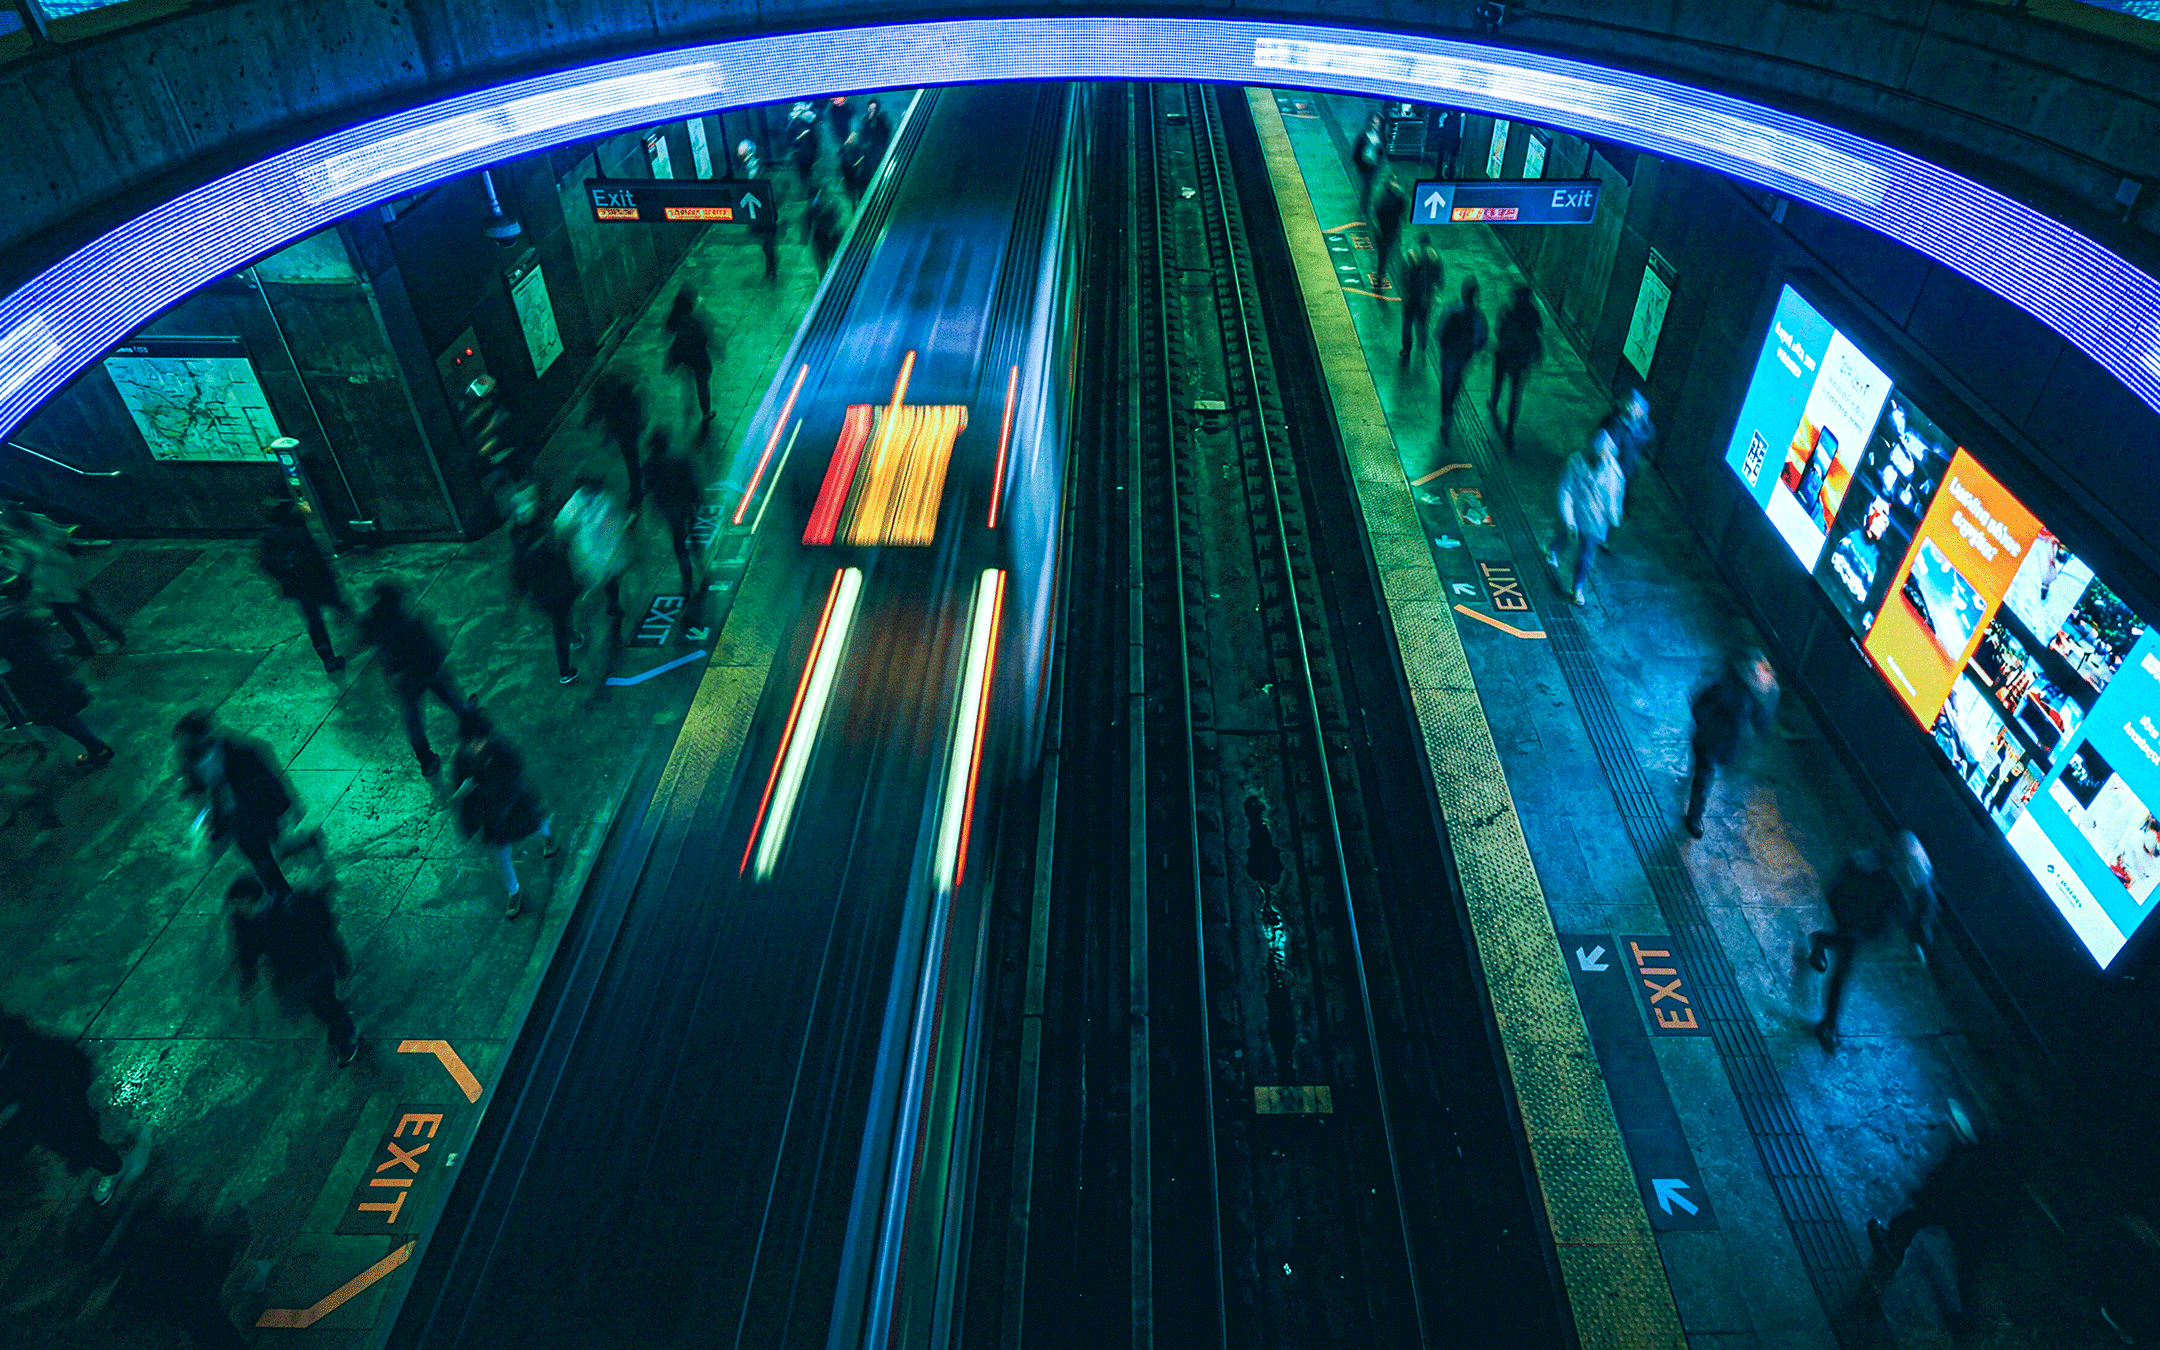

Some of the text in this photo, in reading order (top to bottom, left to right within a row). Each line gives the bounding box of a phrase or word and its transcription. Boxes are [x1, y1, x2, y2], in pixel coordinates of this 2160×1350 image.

[592, 189, 637, 207] Exit
[1551, 190, 1593, 208] Exit
[1481, 563, 1528, 610] EXIT
[638, 596, 685, 645] EXIT
[1630, 941, 1698, 1029] EXIT
[358, 1113, 443, 1224] EXIT
